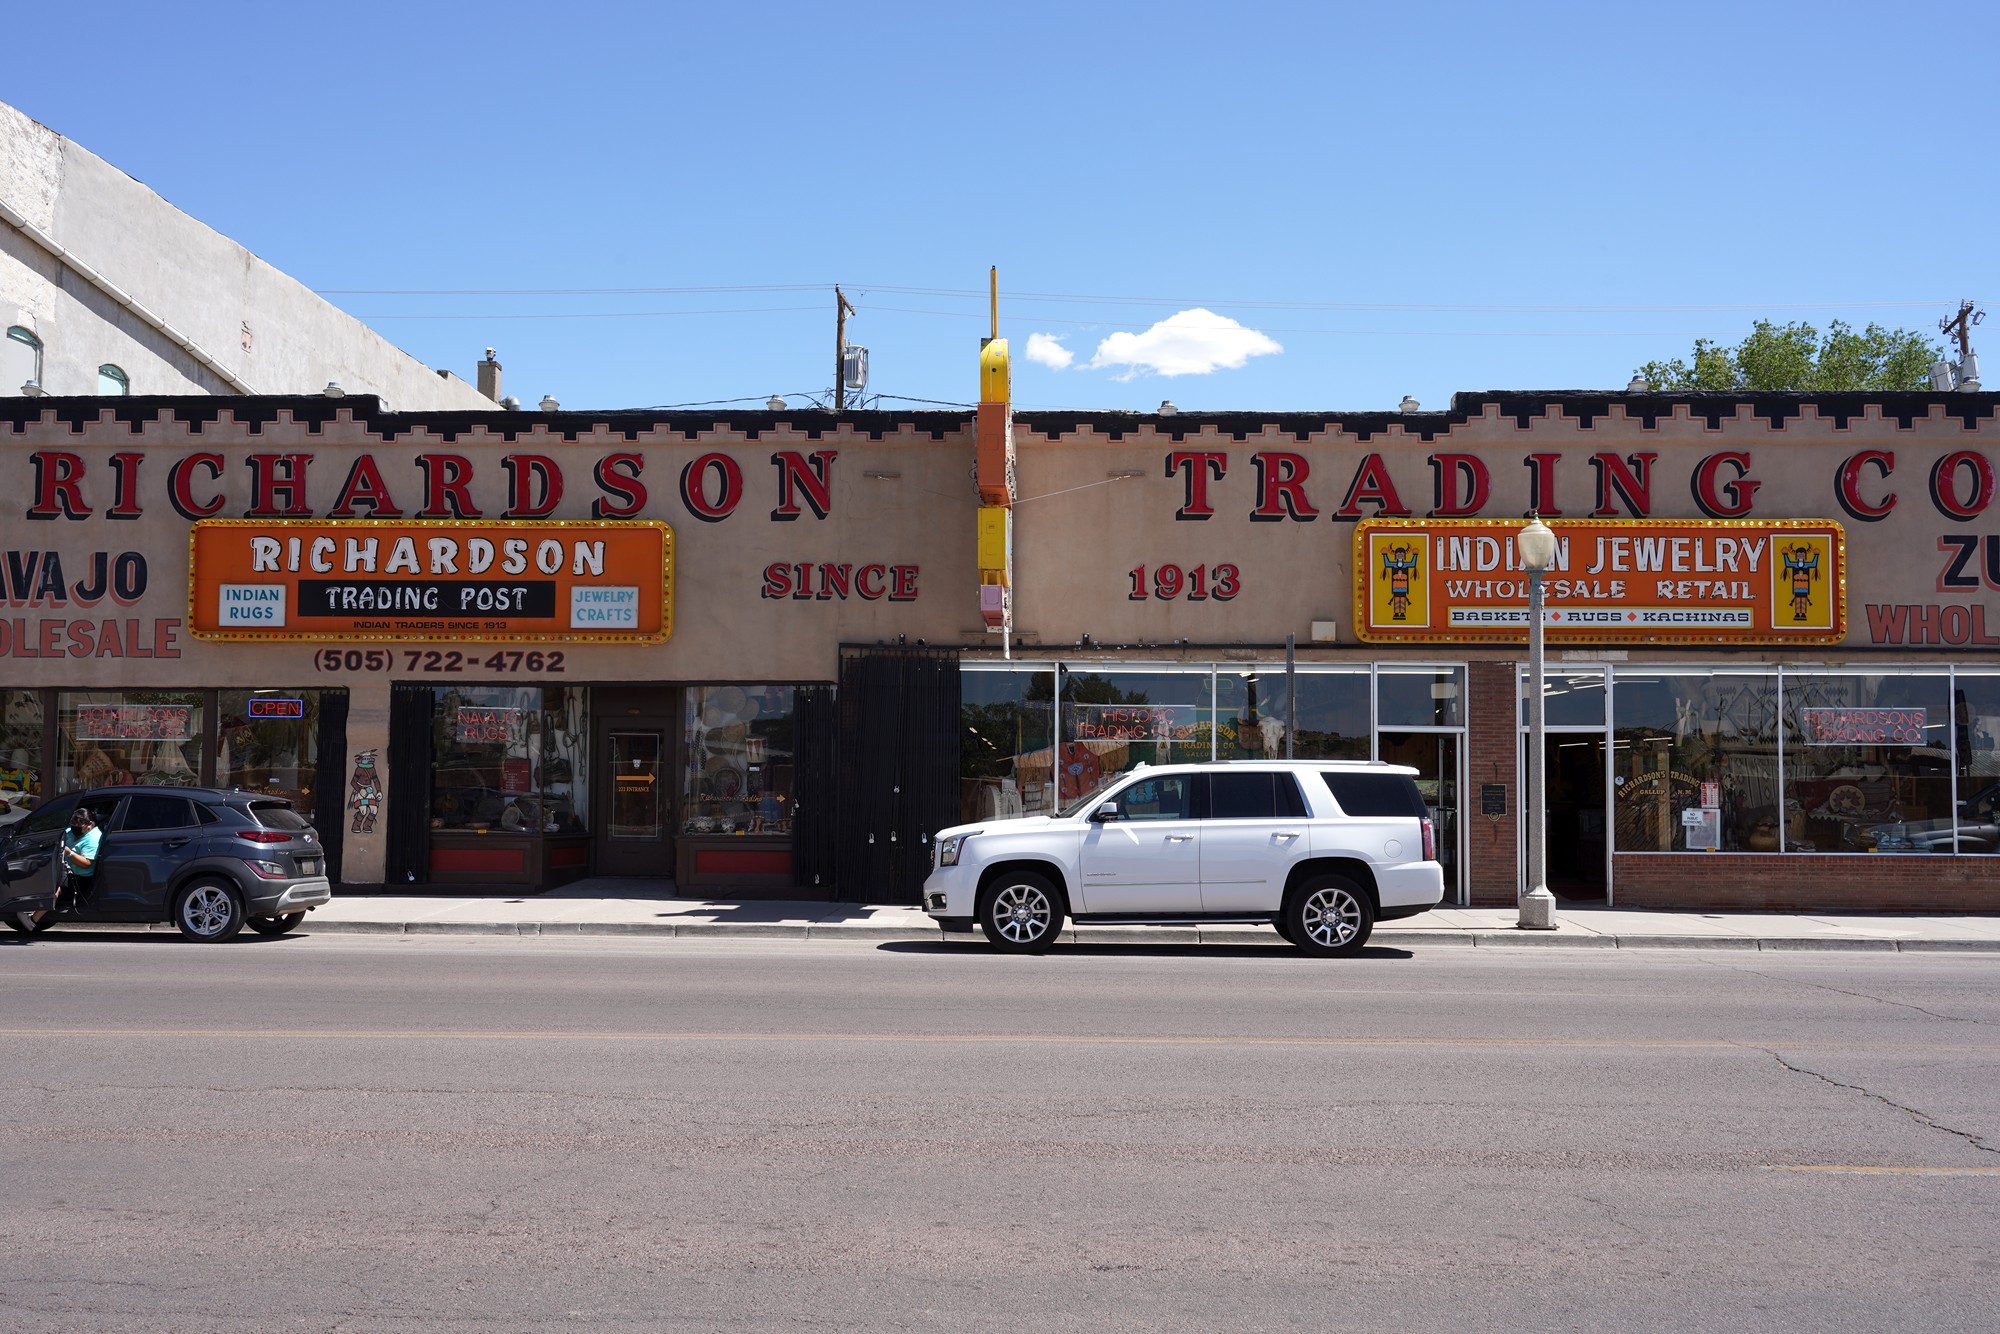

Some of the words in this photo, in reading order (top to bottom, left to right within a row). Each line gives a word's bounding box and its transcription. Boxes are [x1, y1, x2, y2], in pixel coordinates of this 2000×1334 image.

[26, 451, 838, 522] RICHARDSON
[1165, 451, 1762, 522] TRADING
[1834, 450, 1997, 522] CO
[250, 536, 606, 576] RICHARDSON
[1436, 536, 1570, 572] INDIN
[1586, 536, 1767, 575] JEWELRY
[0, 551, 148, 609] VAJO
[761, 563, 920, 602] SINCE
[1129, 564, 1241, 601] 1913
[226, 589, 280, 601] INDIAN
[1656, 579, 1757, 599] RETAIL
[325, 586, 438, 610] TRADING
[460, 587, 528, 611] POST
[575, 591, 634, 603] JEWELRY
[229, 606, 273, 619] RUGS
[576, 608, 632, 621] CRAFTS
[1452, 612, 1546, 621] BASKET
[1567, 612, 1622, 622] RUGS
[1643, 612, 1749, 622] KACHINAS
[353, 621, 390, 629] INDIAN
[395, 621, 445, 629] TRADERS
[447, 621, 479, 629] SINCE
[483, 621, 507, 629] 1913
[1865, 604, 2000, 645] WHOL
[314, 649, 393, 672] (505)
[403, 651, 565, 673] 722-4762
[251, 702, 299, 715] OPEN
[1103, 708, 1175, 722] HISTORIC
[458, 711, 517, 724] NAVAJO
[1804, 711, 1924, 725] RICHARDSONS
[87, 722, 151, 737] TRADING
[465, 726, 508, 741] RUGS
[1075, 724, 1147, 738] TRADING
[1176, 720, 1237, 740] RICHARSON
[1813, 727, 1886, 742] TRADING
[1670, 770, 1700, 787] TRADING
